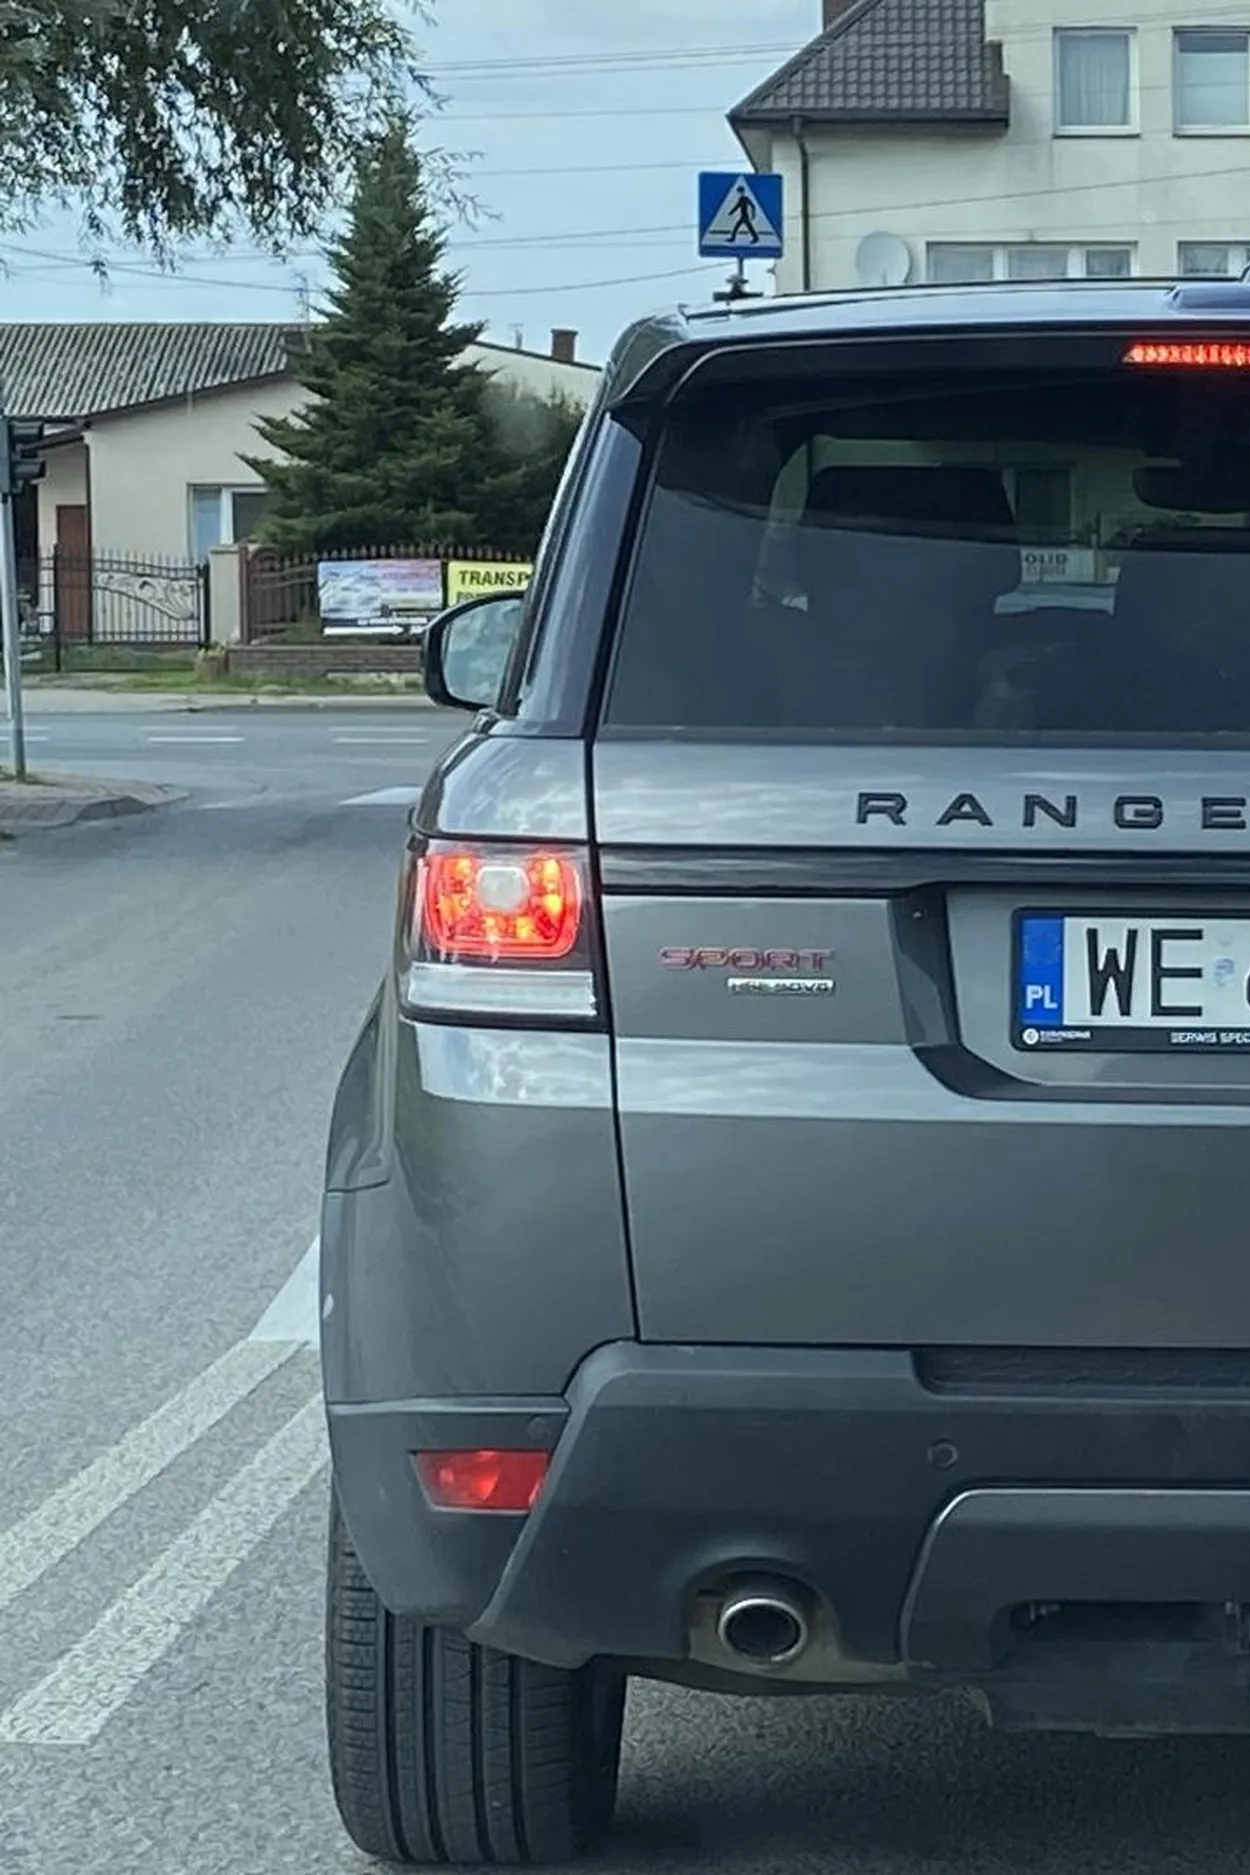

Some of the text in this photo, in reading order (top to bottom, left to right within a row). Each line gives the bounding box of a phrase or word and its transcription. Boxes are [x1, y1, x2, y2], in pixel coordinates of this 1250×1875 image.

[855, 791, 1248, 831] RANGE
[658, 946, 834, 972] SPORT
[1085, 927, 1204, 1018] WE
[1026, 984, 1059, 1009] PL
